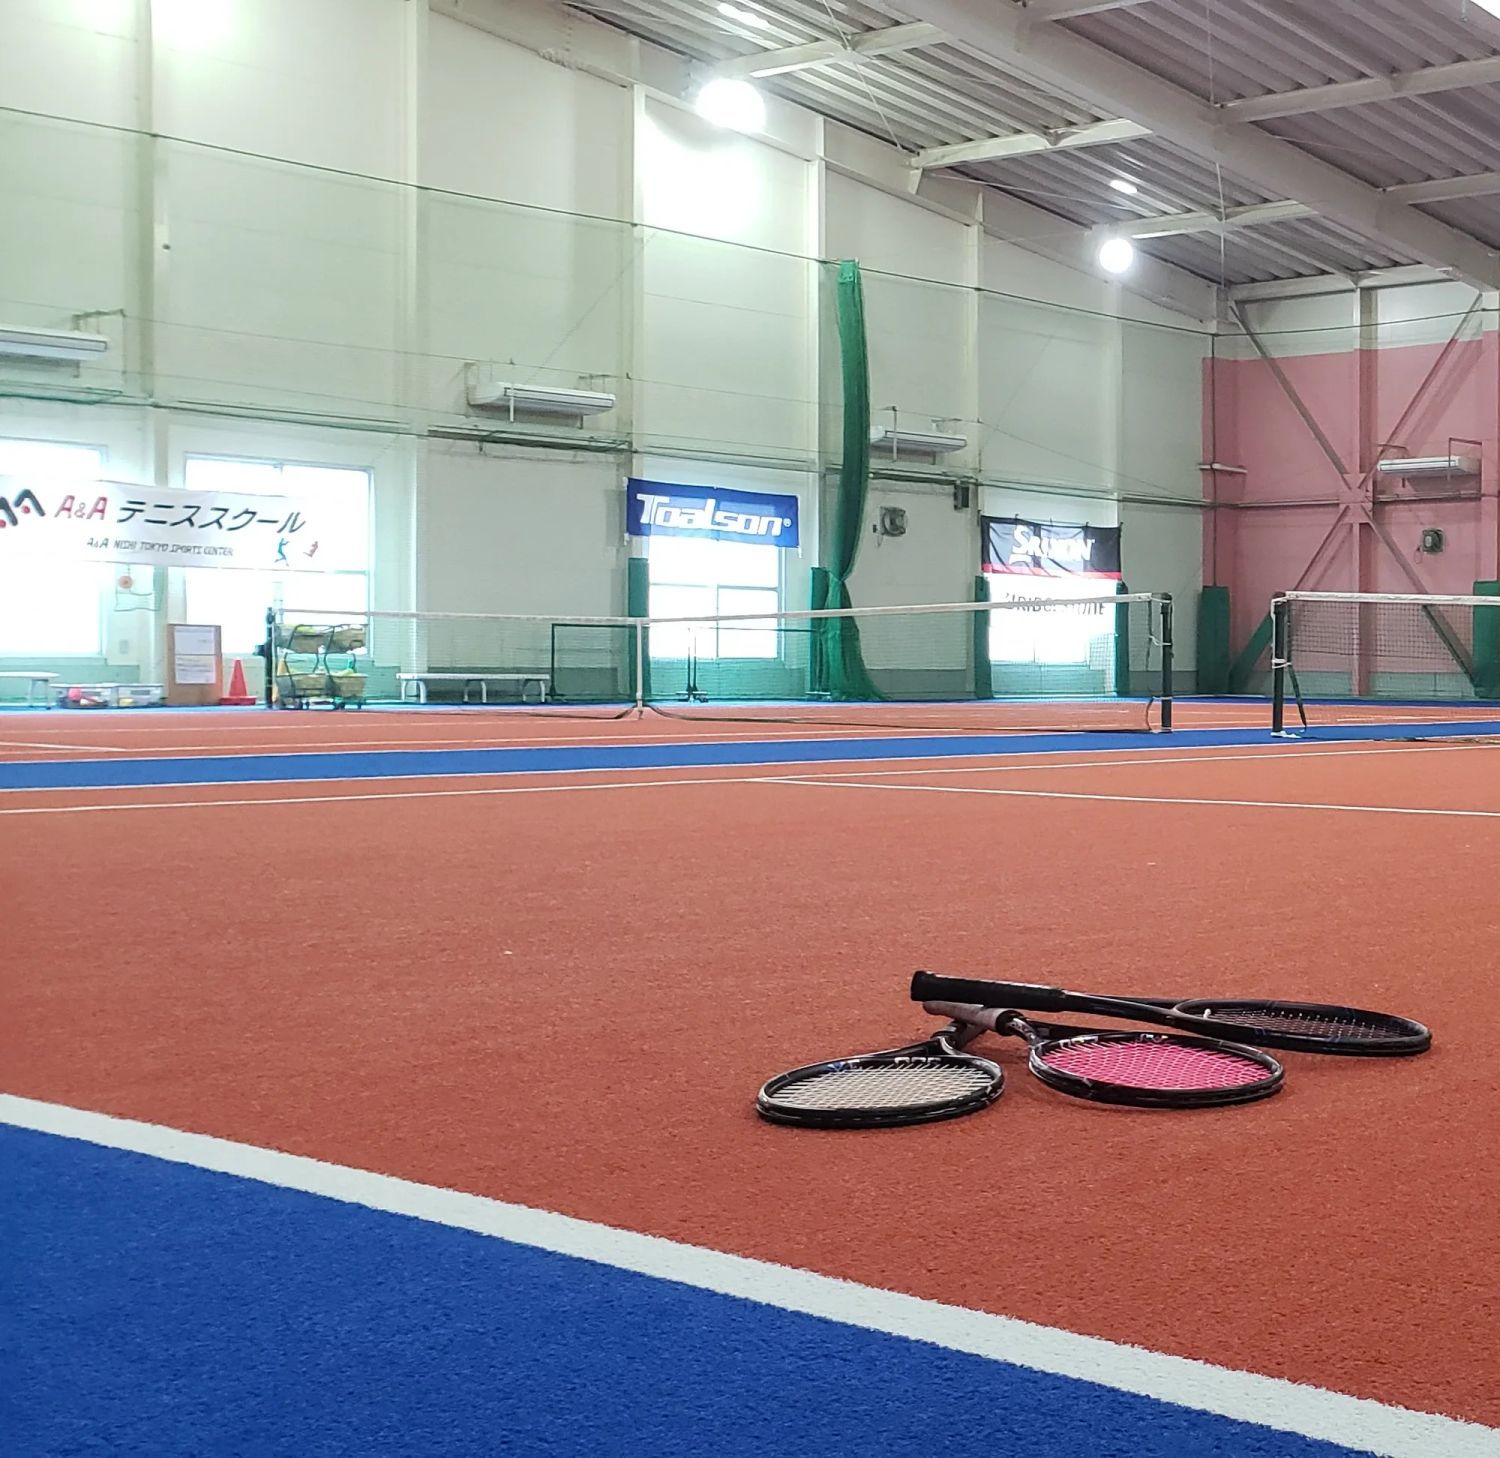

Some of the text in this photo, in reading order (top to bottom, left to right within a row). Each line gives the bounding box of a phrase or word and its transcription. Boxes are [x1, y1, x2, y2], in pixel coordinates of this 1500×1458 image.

[55, 495, 306, 534] A&A テニススクール
